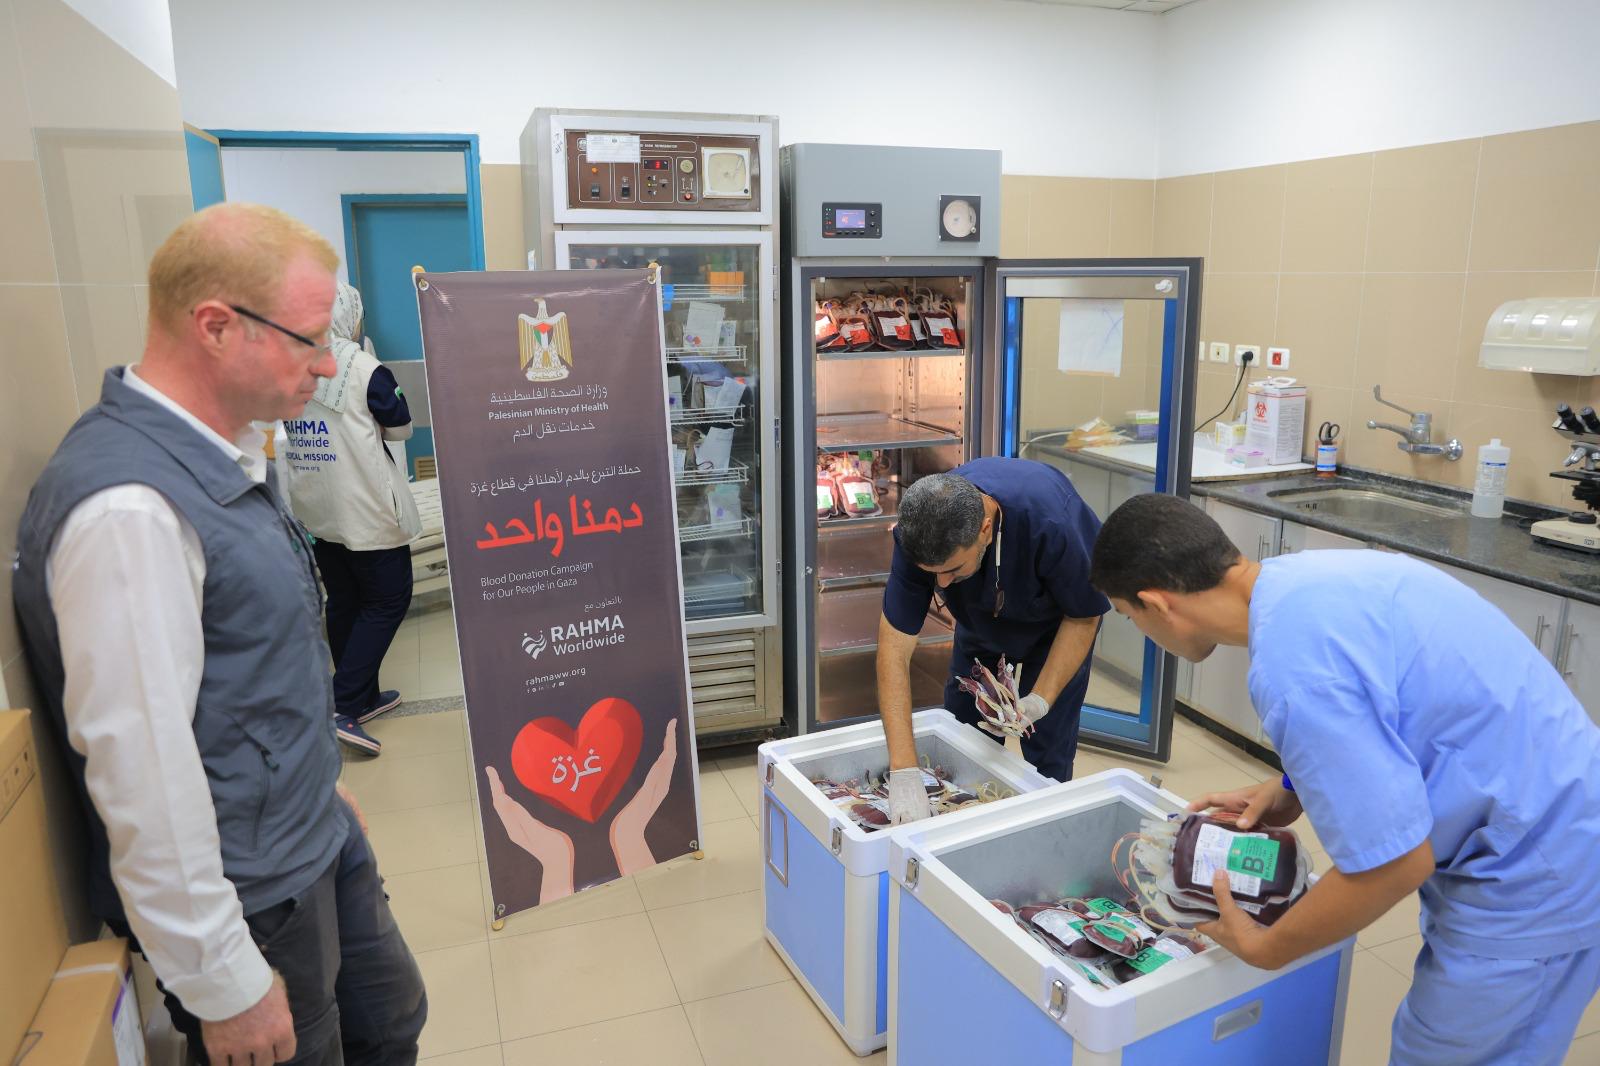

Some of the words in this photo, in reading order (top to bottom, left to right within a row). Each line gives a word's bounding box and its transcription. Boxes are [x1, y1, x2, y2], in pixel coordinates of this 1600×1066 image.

[490, 387, 549, 405] الفلسطينية
[550, 385, 583, 398] الصحة
[586, 383, 608, 400] وزارة
[488, 409, 533, 420] Palesinian
[534, 406, 569, 416] Ministry
[571, 404, 580, 413] of
[581, 402, 609, 412] Health
[513, 424, 533, 443] الدم
[536, 422, 556, 439] نقل
[558, 419, 596, 433] خدمات
[303, 453, 336, 461] MISSION
[565, 469, 590, 487] بالدم
[591, 466, 616, 484] التبرع
[618, 464, 641, 475] حملة
[470, 480, 488, 497] غزة
[490, 477, 516, 496] قطاع
[517, 477, 534, 493] في
[569, 494, 643, 536] دمنا
[476, 498, 564, 558] واحد
[480, 573, 507, 587] Blood
[508, 568, 549, 583] Donation
[550, 561, 594, 576] Campaign
[482, 590, 495, 601] for
[497, 588, 514, 599] Our
[515, 582, 545, 595] People
[547, 580, 556, 590] in
[556, 577, 578, 588] Gaza
[584, 602, 594, 613] مع
[550, 614, 625, 643] RAHMA
[552, 632, 626, 656] Worldwide
[525, 666, 587, 686] rahmaww.org
[551, 748, 602, 793] غزة
[1240, 855, 1264, 874] B
[1102, 900, 1117, 910] B
[1136, 951, 1150, 963] B
